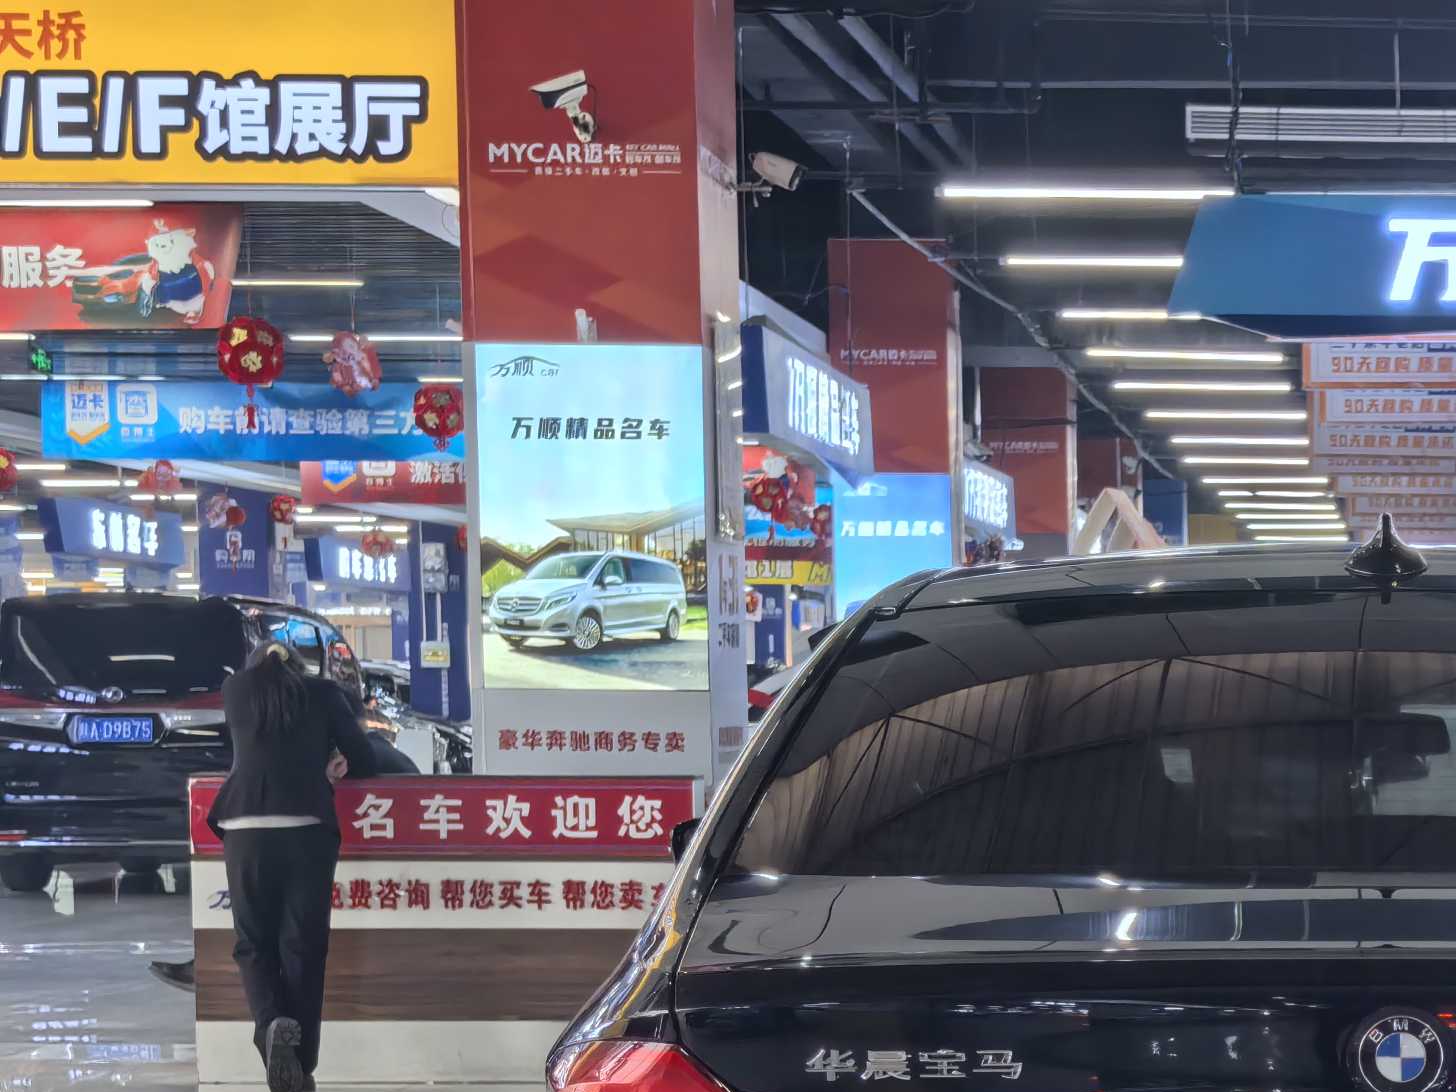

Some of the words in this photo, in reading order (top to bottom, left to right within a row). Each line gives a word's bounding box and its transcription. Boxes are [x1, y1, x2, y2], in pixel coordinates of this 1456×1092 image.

[1, 245, 87, 289] 服务
[511, 417, 672, 440] 万顺精品名车
[498, 728, 686, 752] 豪华奔驰商务专卖
[353, 793, 664, 840] 名车欢迎您
[441, 880, 552, 910] 帮您买车
[1368, 1019, 1436, 1044] BMW
[804, 1048, 1024, 1082] 华晨宝马
